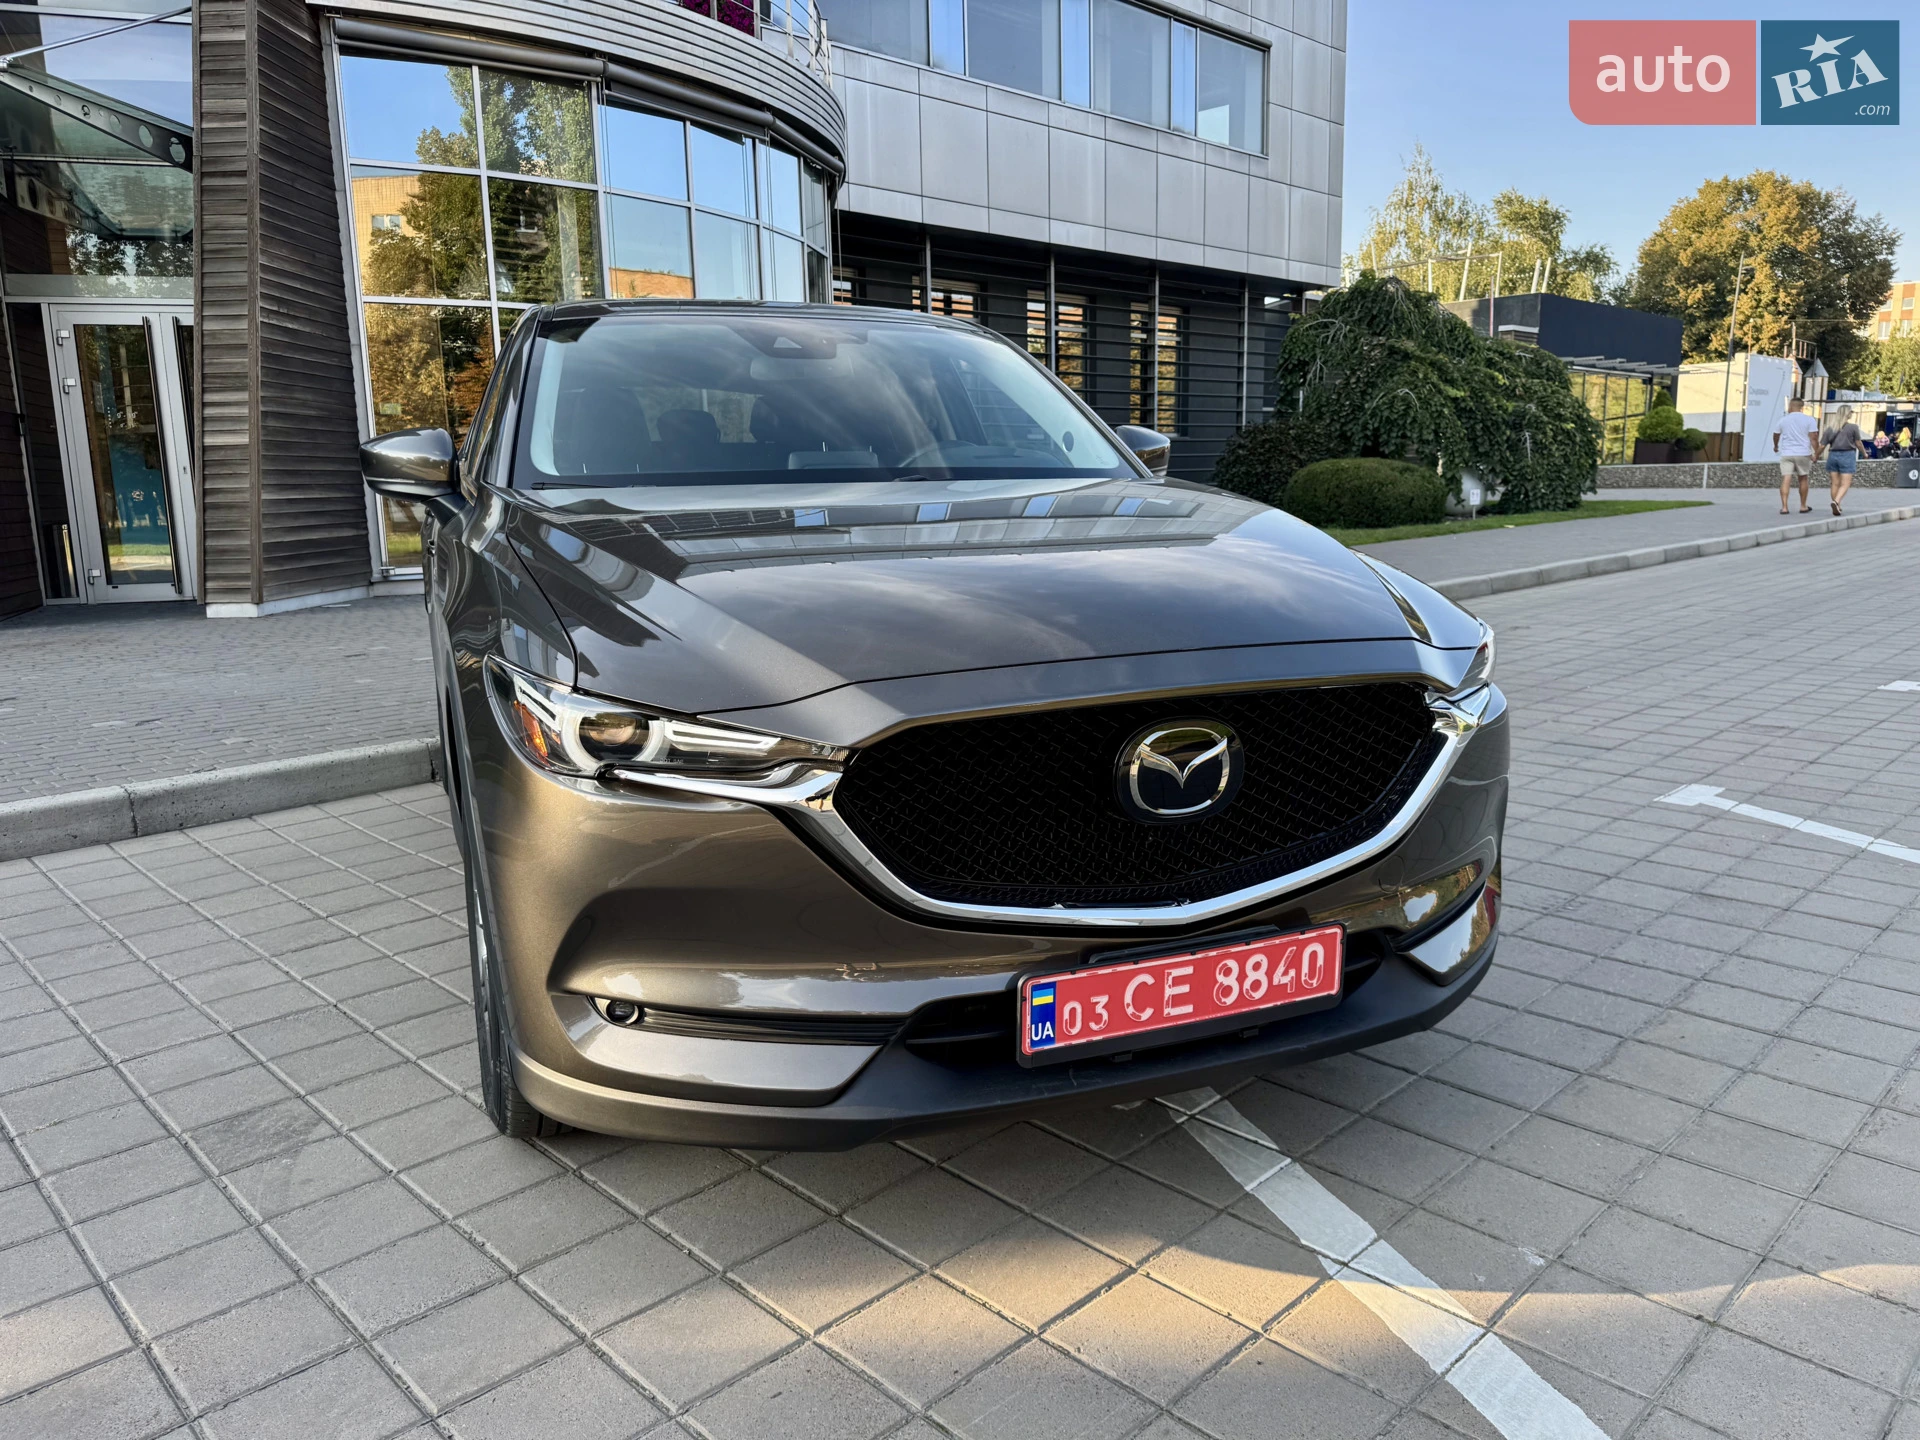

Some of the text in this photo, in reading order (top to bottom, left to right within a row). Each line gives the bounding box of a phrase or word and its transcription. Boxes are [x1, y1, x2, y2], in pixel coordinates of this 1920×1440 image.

[1062, 942, 1325, 1036] 03 CE 8840
[1031, 1021, 1054, 1041] UA
